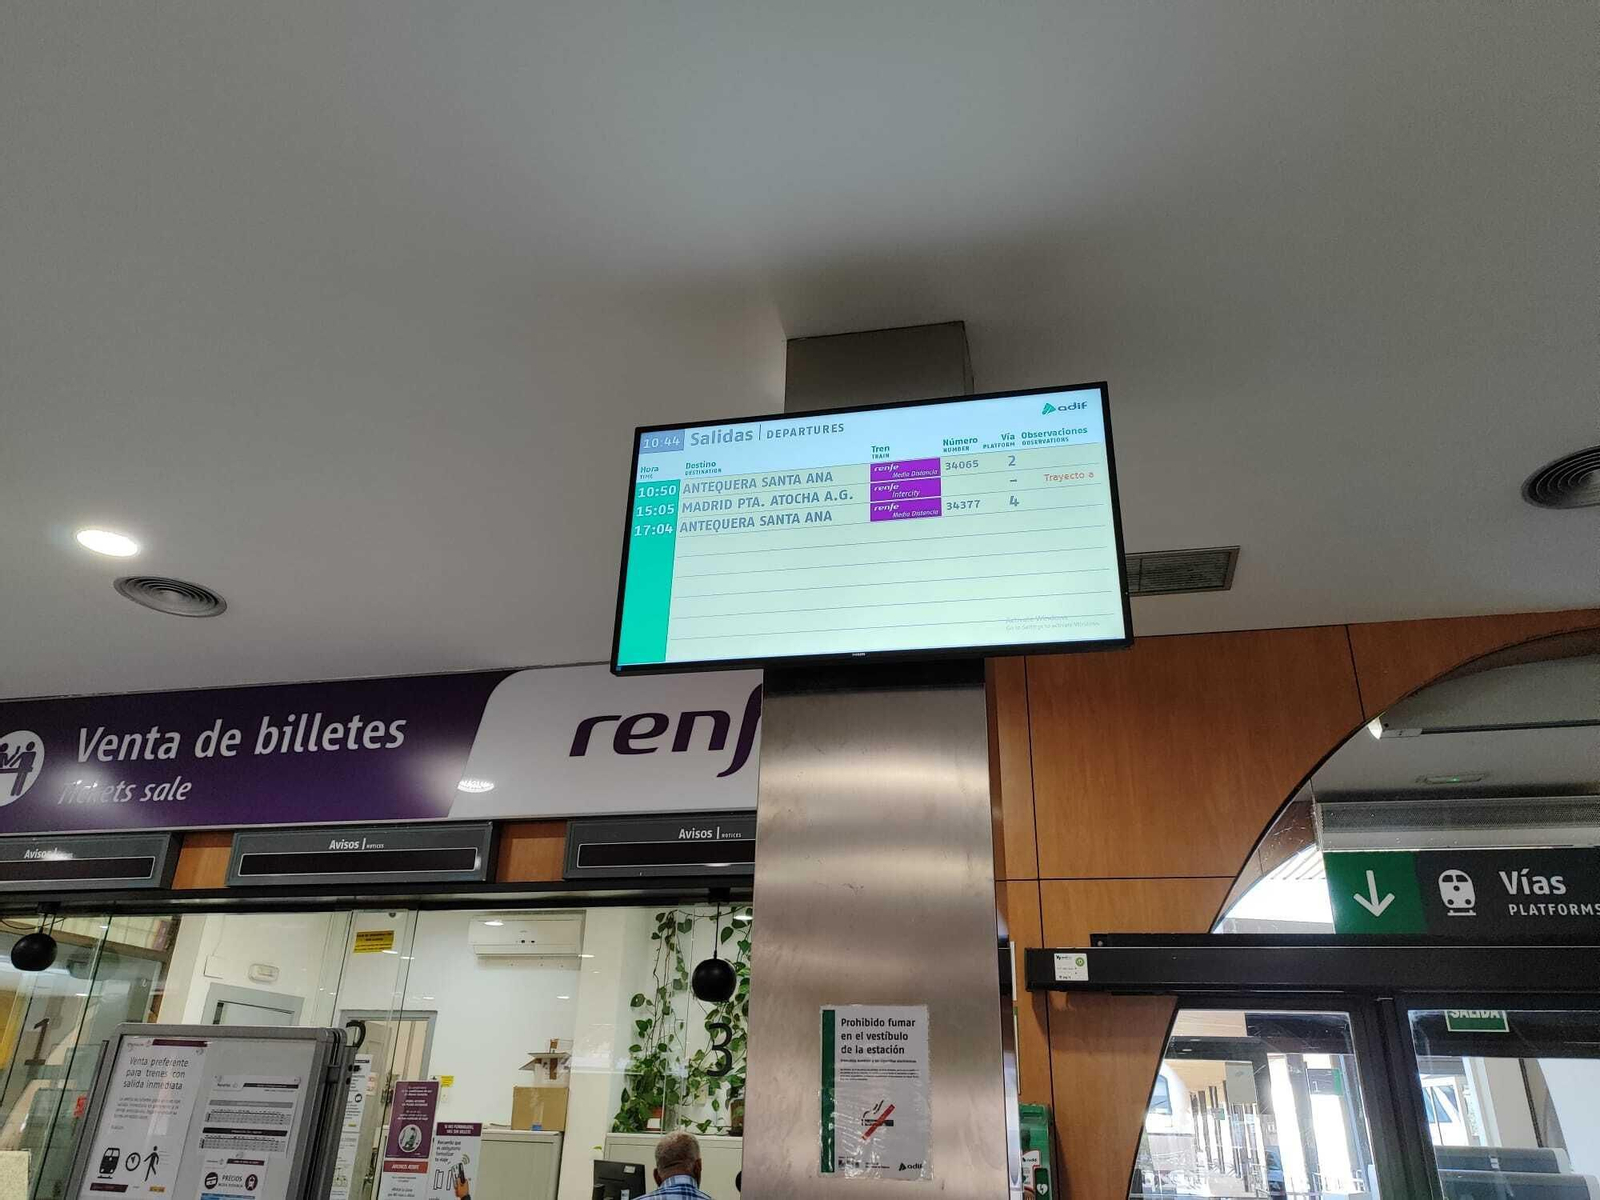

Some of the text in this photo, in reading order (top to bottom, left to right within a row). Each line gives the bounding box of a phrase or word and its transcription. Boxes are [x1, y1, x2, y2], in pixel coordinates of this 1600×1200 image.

[1057, 401, 1088, 411] adif
[766, 423, 845, 439] DEPARTURES
[1001, 432, 1015, 441] Vía
[1021, 426, 1088, 440] Observaciones
[642, 435, 681, 449] 10:44
[690, 428, 753, 446] Salidas
[943, 436, 978, 446] Número
[871, 445, 890, 453] Tren
[983, 441, 1015, 449] PLATFORM
[685, 460, 716, 469] Destino
[945, 460, 979, 471] 34065
[1008, 455, 1016, 467] 2
[641, 465, 659, 473] Hora
[873, 464, 899, 472] renfe
[892, 468, 938, 478] Media Distancia
[683, 471, 833, 494] ANTEQUERA SANTA ANA
[1044, 472, 1085, 482] Trayecto
[638, 485, 677, 498] 10:50
[874, 483, 900, 492] renfe
[892, 489, 921, 499] Intercity
[681, 490, 853, 513] MADRID PTA. ATOCHA A.G.
[946, 500, 980, 510] 34377
[1010, 496, 1019, 507] 4
[637, 504, 675, 517] 15:05
[874, 503, 900, 512] renfe
[892, 508, 938, 518] Media Distancia
[679, 510, 832, 533] ANTEQUERA SANTA ANA
[634, 523, 673, 537] 17:04
[77, 712, 407, 763] Venta de billetes
[58, 776, 192, 805] Tickets sale
[678, 827, 713, 840] Avisos
[329, 838, 360, 850] Avisos
[24, 848, 52, 859] Avisos
[1499, 868, 1567, 895] Vías
[1508, 903, 1600, 916] PLATFORMS
[841, 1018, 915, 1027] Prohibido fumar
[841, 1031, 908, 1041] en el vestíbulo
[24, 1018, 49, 1066] 1
[706, 1023, 732, 1077] 3
[841, 1045, 905, 1055] de la estación
[129, 1056, 189, 1068] Venta preferente
[126, 1069, 142, 1078] para
[146, 1069, 168, 1078] trenes
[123, 1079, 183, 1090] salida inmediata
